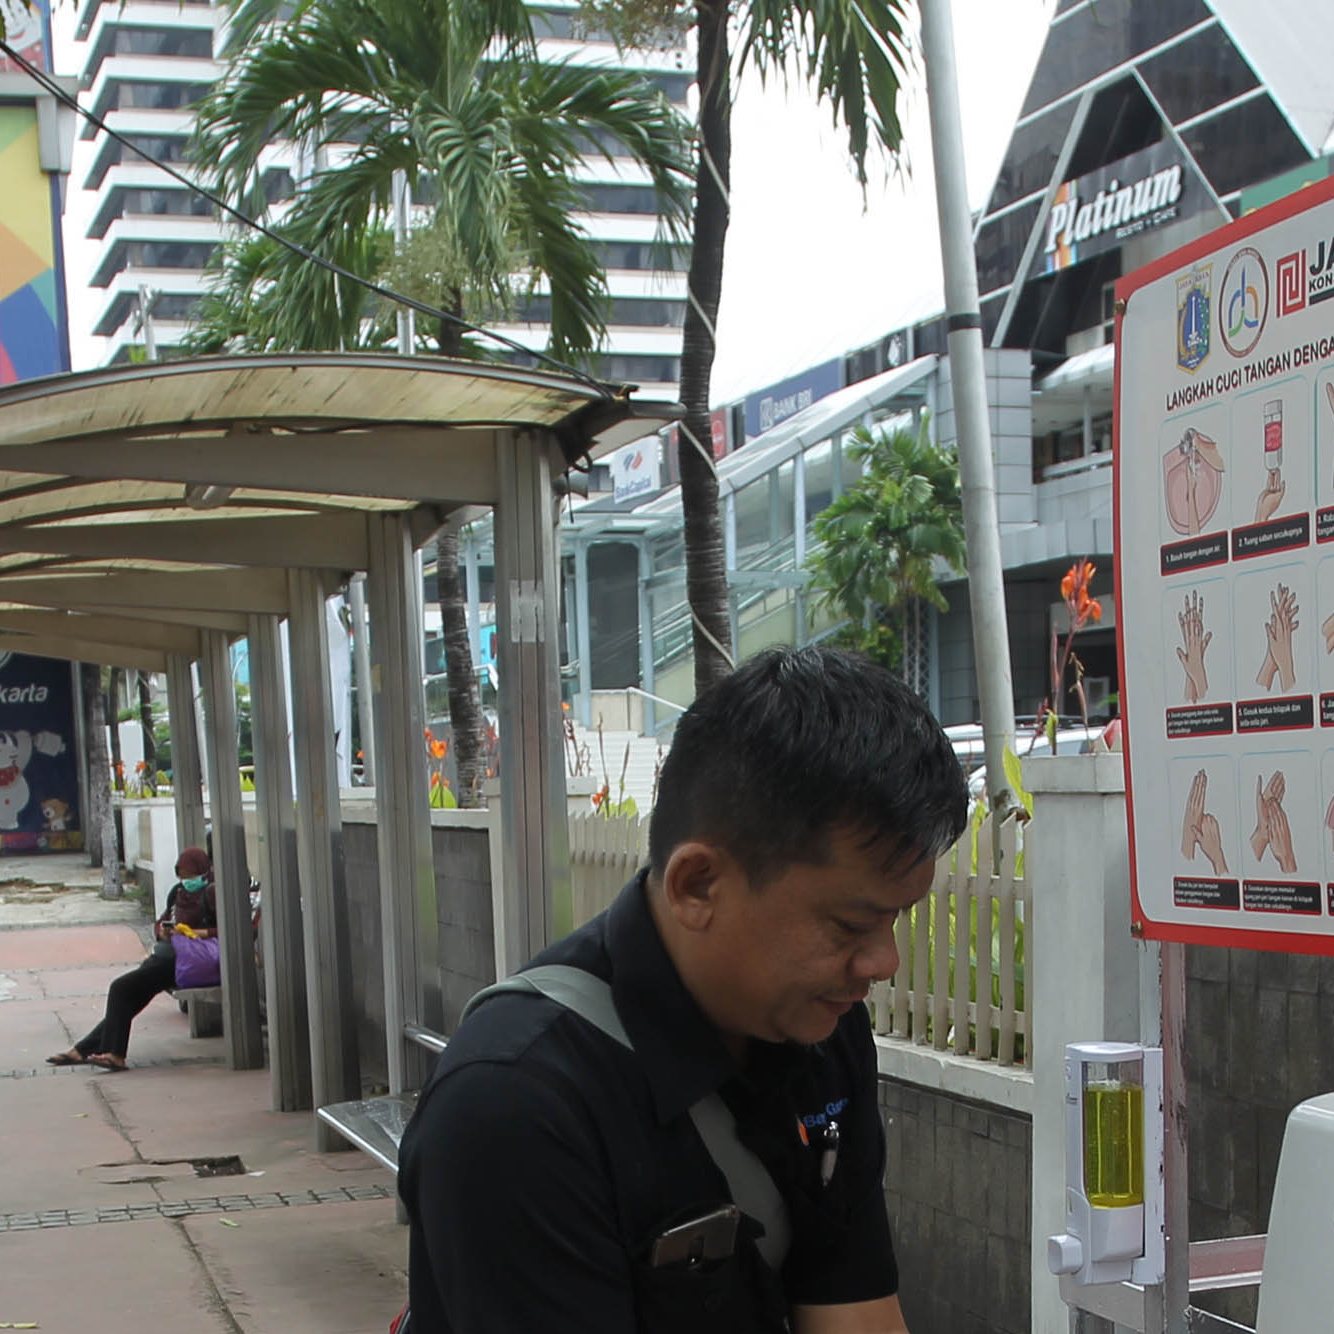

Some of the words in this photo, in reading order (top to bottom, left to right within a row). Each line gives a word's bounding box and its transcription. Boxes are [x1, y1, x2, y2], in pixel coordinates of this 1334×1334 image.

[1044, 165, 1183, 254] Platinum
[1166, 376, 1214, 411] LANGKAH
[1216, 369, 1242, 393] CUCI
[1244, 353, 1291, 383] TANGAN
